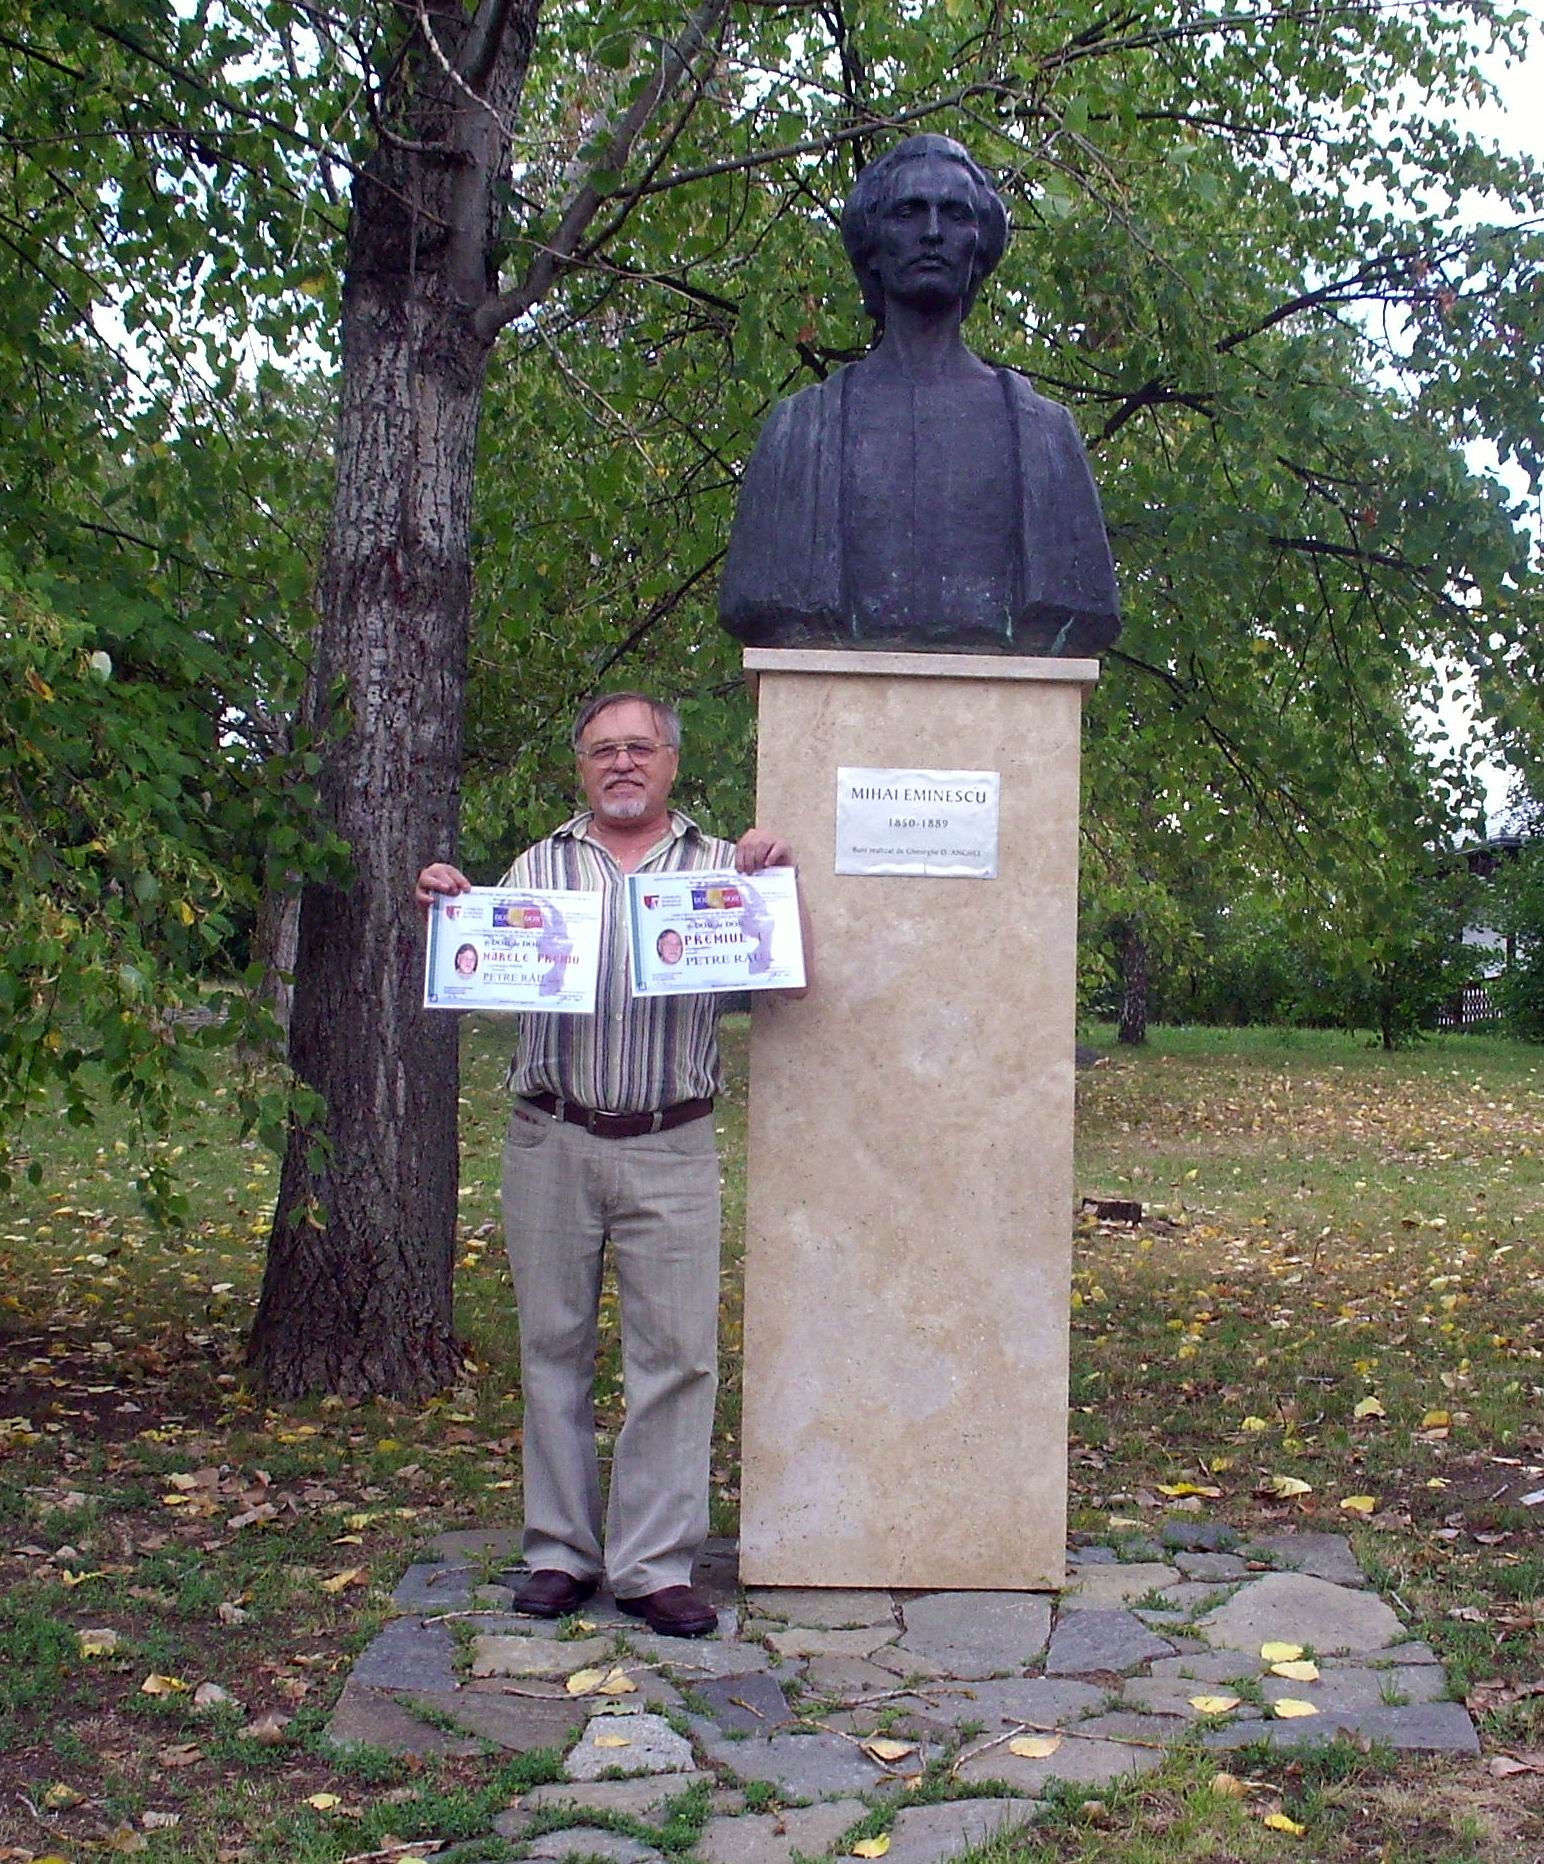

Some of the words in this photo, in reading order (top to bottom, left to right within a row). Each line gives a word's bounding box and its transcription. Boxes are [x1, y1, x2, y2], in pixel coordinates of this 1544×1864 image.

[851, 787, 898, 801] MIHAI
[904, 789, 986, 804] EMINESCU
[888, 817, 949, 828] 1850-1889
[684, 932, 747, 946] PREMIUL
[483, 952, 529, 963] MARELE
[686, 955, 730, 966] PETRE
[483, 972, 518, 982] PETRE
